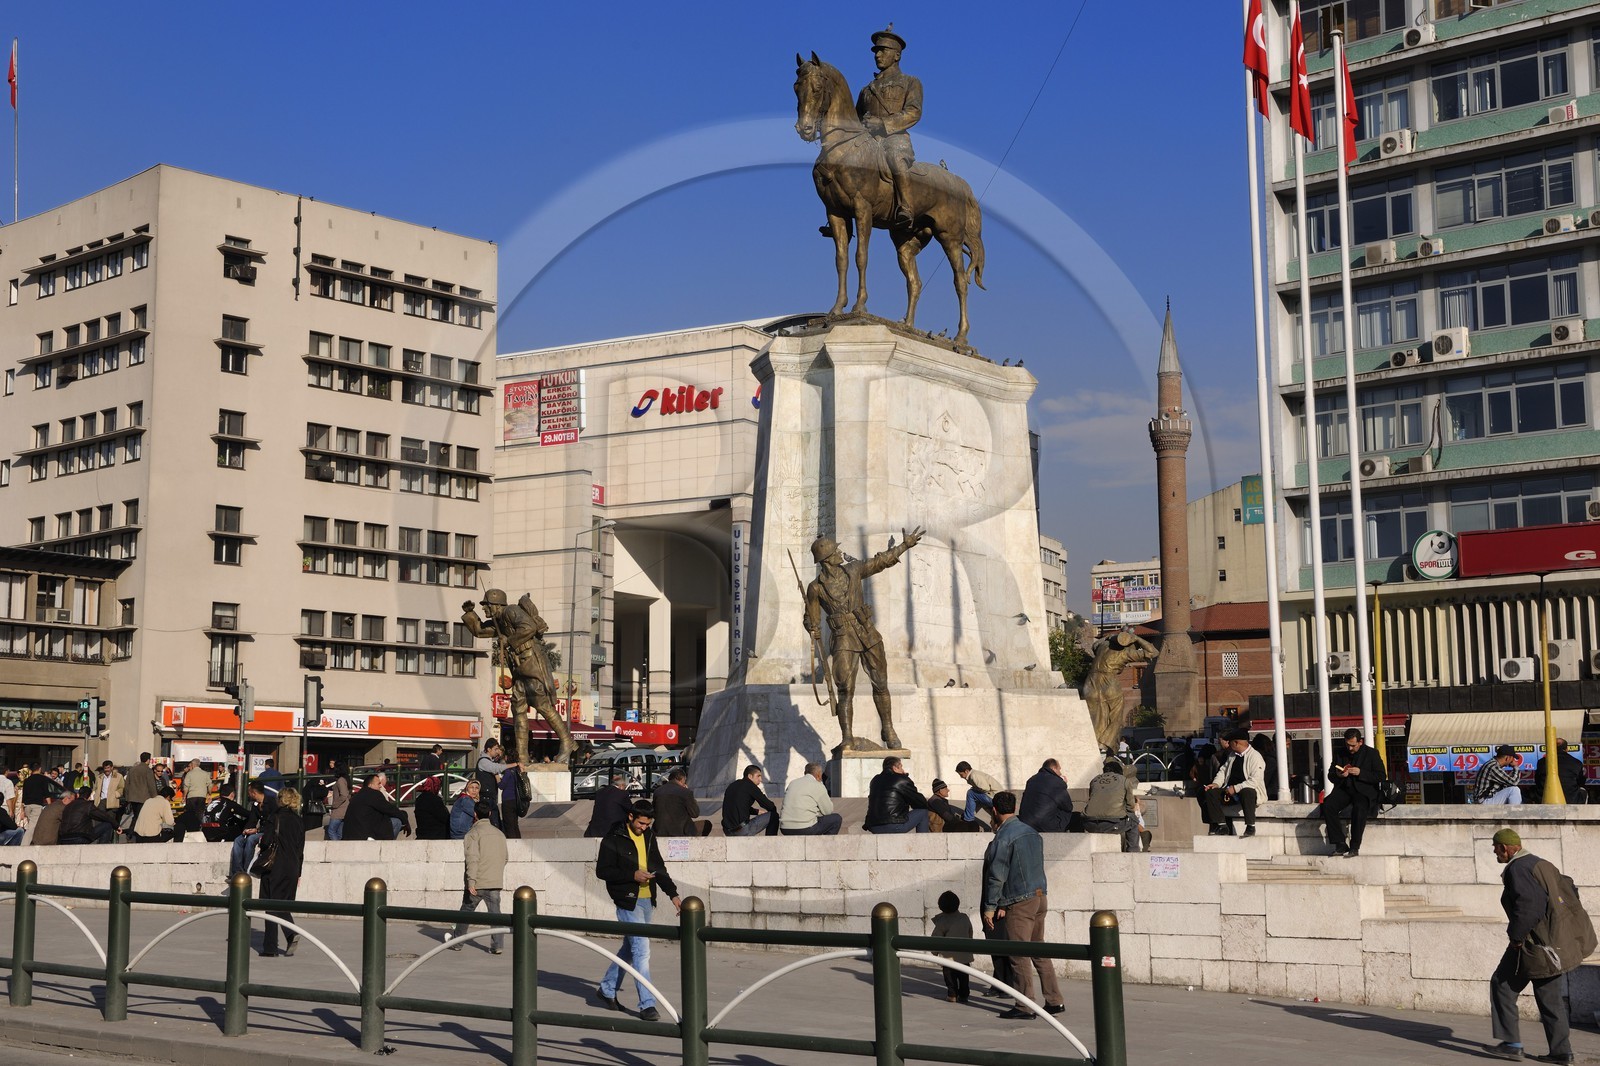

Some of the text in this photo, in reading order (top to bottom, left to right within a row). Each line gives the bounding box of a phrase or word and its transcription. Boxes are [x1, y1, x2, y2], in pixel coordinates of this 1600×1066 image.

[541, 370, 577, 387] TUTKUN
[542, 391, 577, 401] KUAFÖRÜ
[660, 384, 724, 416] kiler
[542, 406, 577, 416] KUAFÖRÜ
[542, 416, 577, 424] GELİNLİK
[544, 432, 575, 443] 29.NOTER
[733, 529, 741, 574] ULUS
[733, 578, 741, 639] ŞEHİR
[80, 701, 89, 709] 18
[335, 719, 367, 730] BANK
[622, 729, 643, 737] vodafone
[1412, 755, 1437, 771] 49
[1453, 754, 1479, 770] 49
